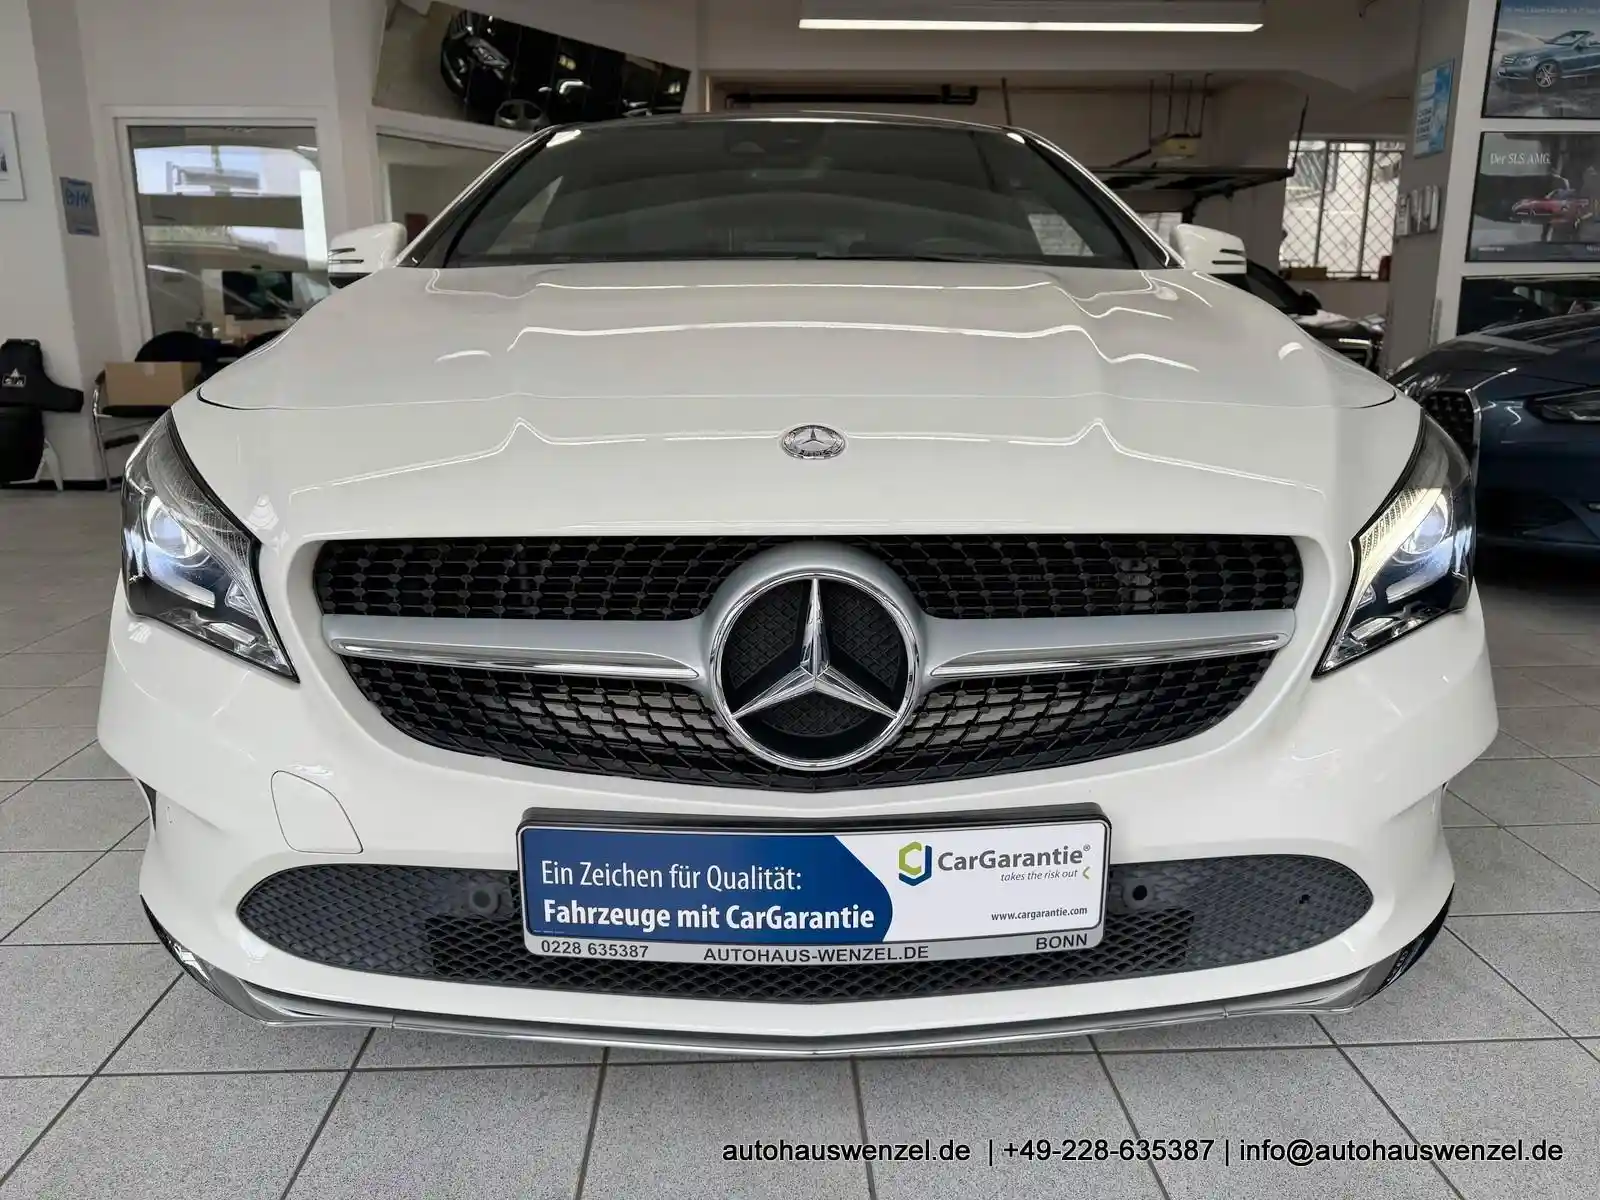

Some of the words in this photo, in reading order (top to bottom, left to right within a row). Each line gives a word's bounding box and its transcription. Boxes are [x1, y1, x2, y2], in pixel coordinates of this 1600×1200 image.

[1489, 152, 1506, 165] Der
[1508, 152, 1526, 164] SLS
[541, 860, 573, 885] Ein
[580, 861, 663, 889] Zeichen
[669, 864, 701, 889] für
[707, 865, 802, 892] Qualität:
[1000, 871, 1025, 882] takes
[1027, 870, 1043, 880] the
[1044, 869, 1060, 879] risk
[1062, 869, 1078, 878] out
[543, 899, 670, 933] Fahrzeuge
[677, 904, 720, 928] mit
[725, 904, 875, 931] CarGarantie
[991, 907, 1088, 921] www.cargarantie.com
[541, 940, 582, 955] 0228
[587, 942, 649, 958] 635387
[1035, 932, 1088, 950] BONN
[703, 945, 929, 963] AUTOHAUS-WENZEL.DE
